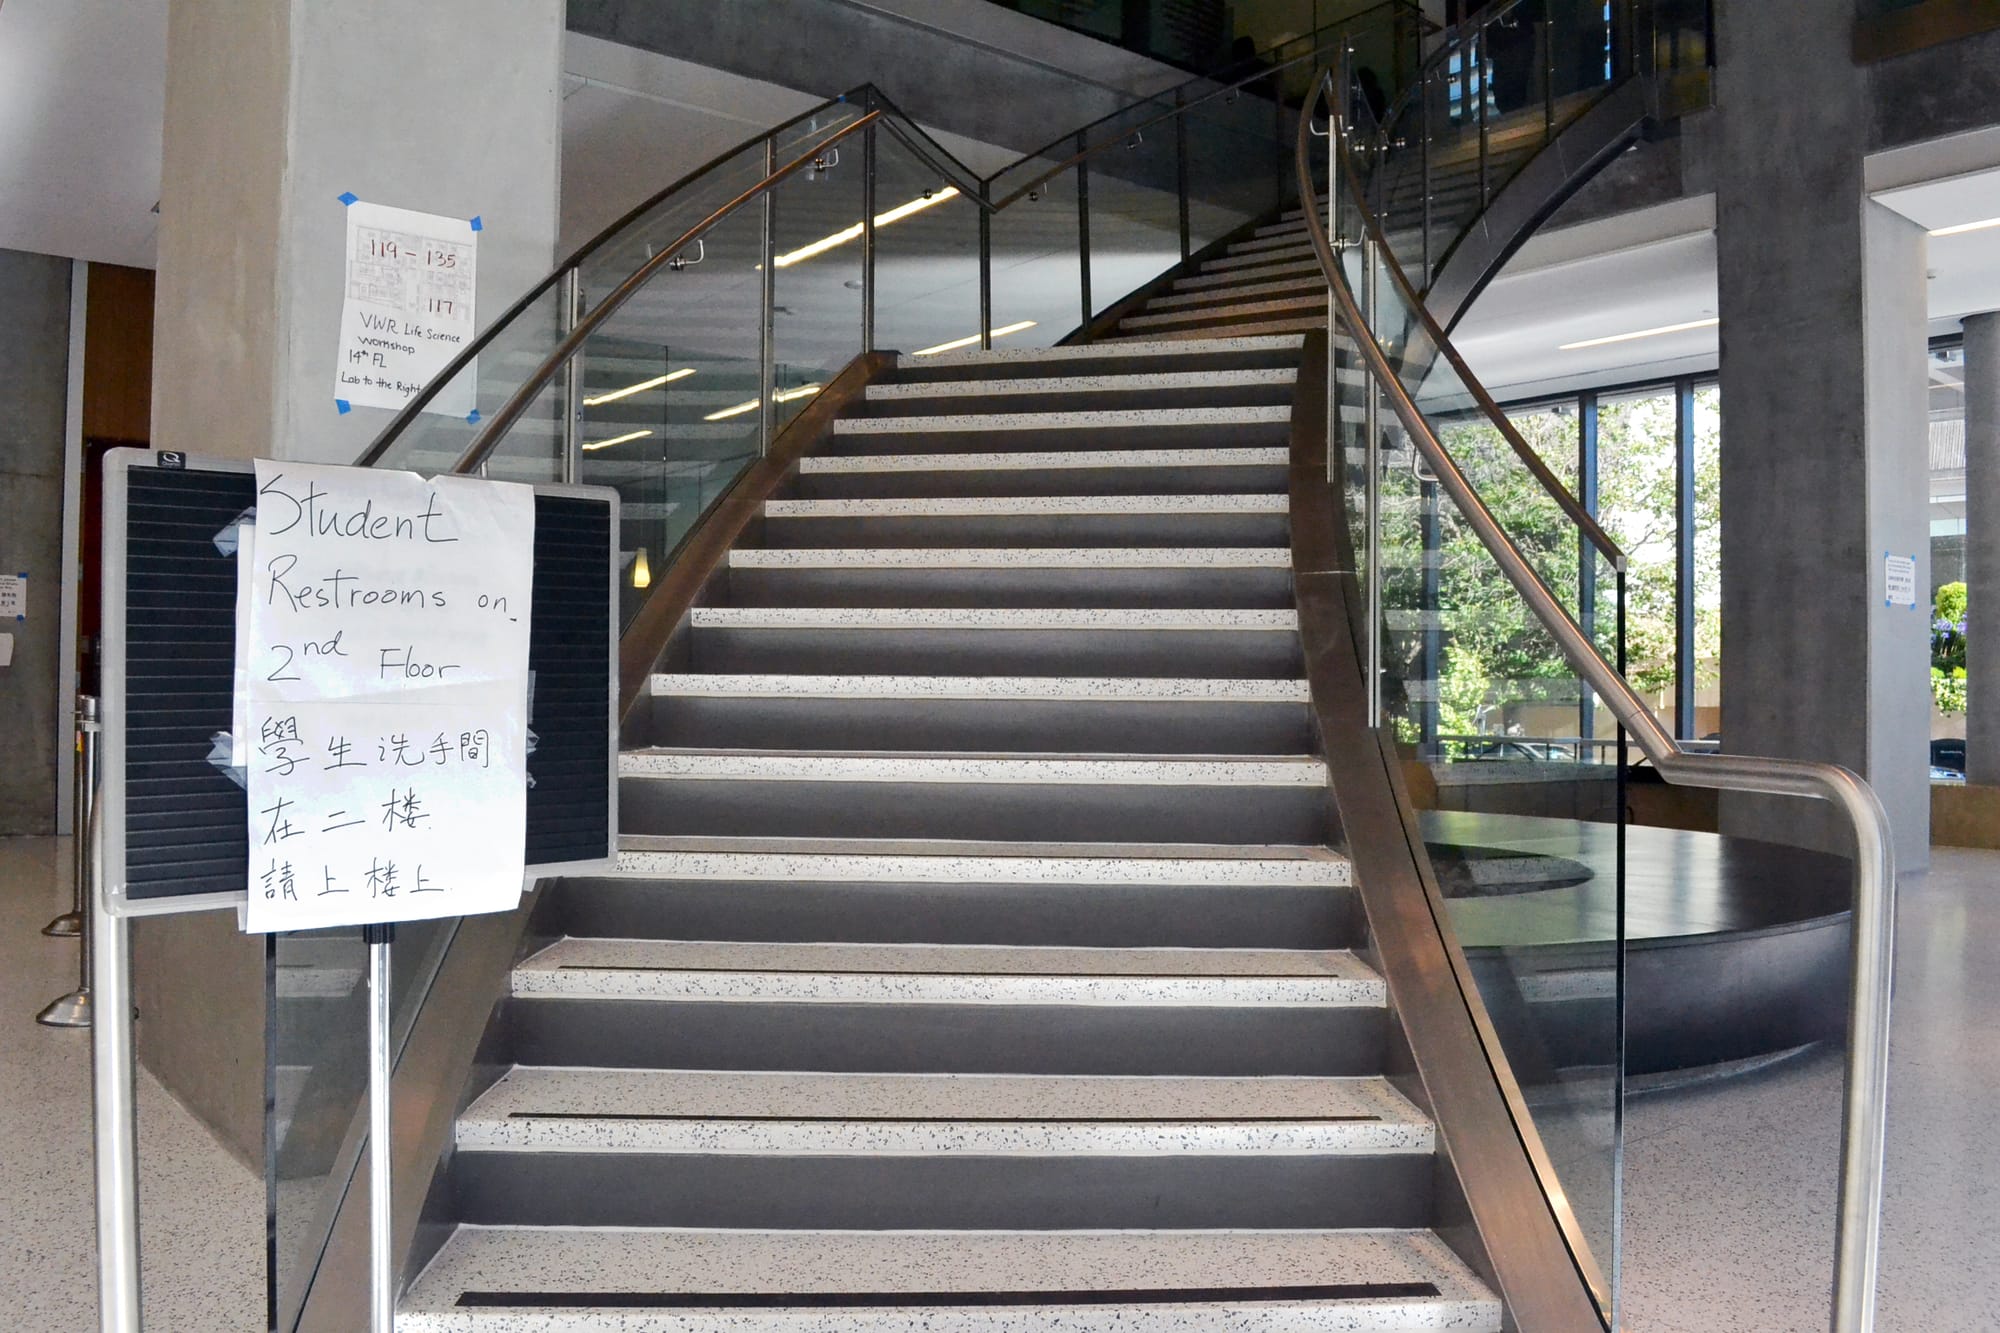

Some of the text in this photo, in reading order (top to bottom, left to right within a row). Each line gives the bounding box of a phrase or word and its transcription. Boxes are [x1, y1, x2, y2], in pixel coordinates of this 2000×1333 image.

[371, 239, 397, 259] 119
[427, 249, 456, 268] 135
[359, 311, 461, 343] VWR Life Science
[429, 298, 453, 315] 117
[341, 371, 421, 398] Lab to the Right
[260, 473, 458, 542] Student
[268, 554, 446, 612] Restrooms
[267, 630, 461, 681] 2nd Floor
[258, 716, 489, 776] 學生洗手間
